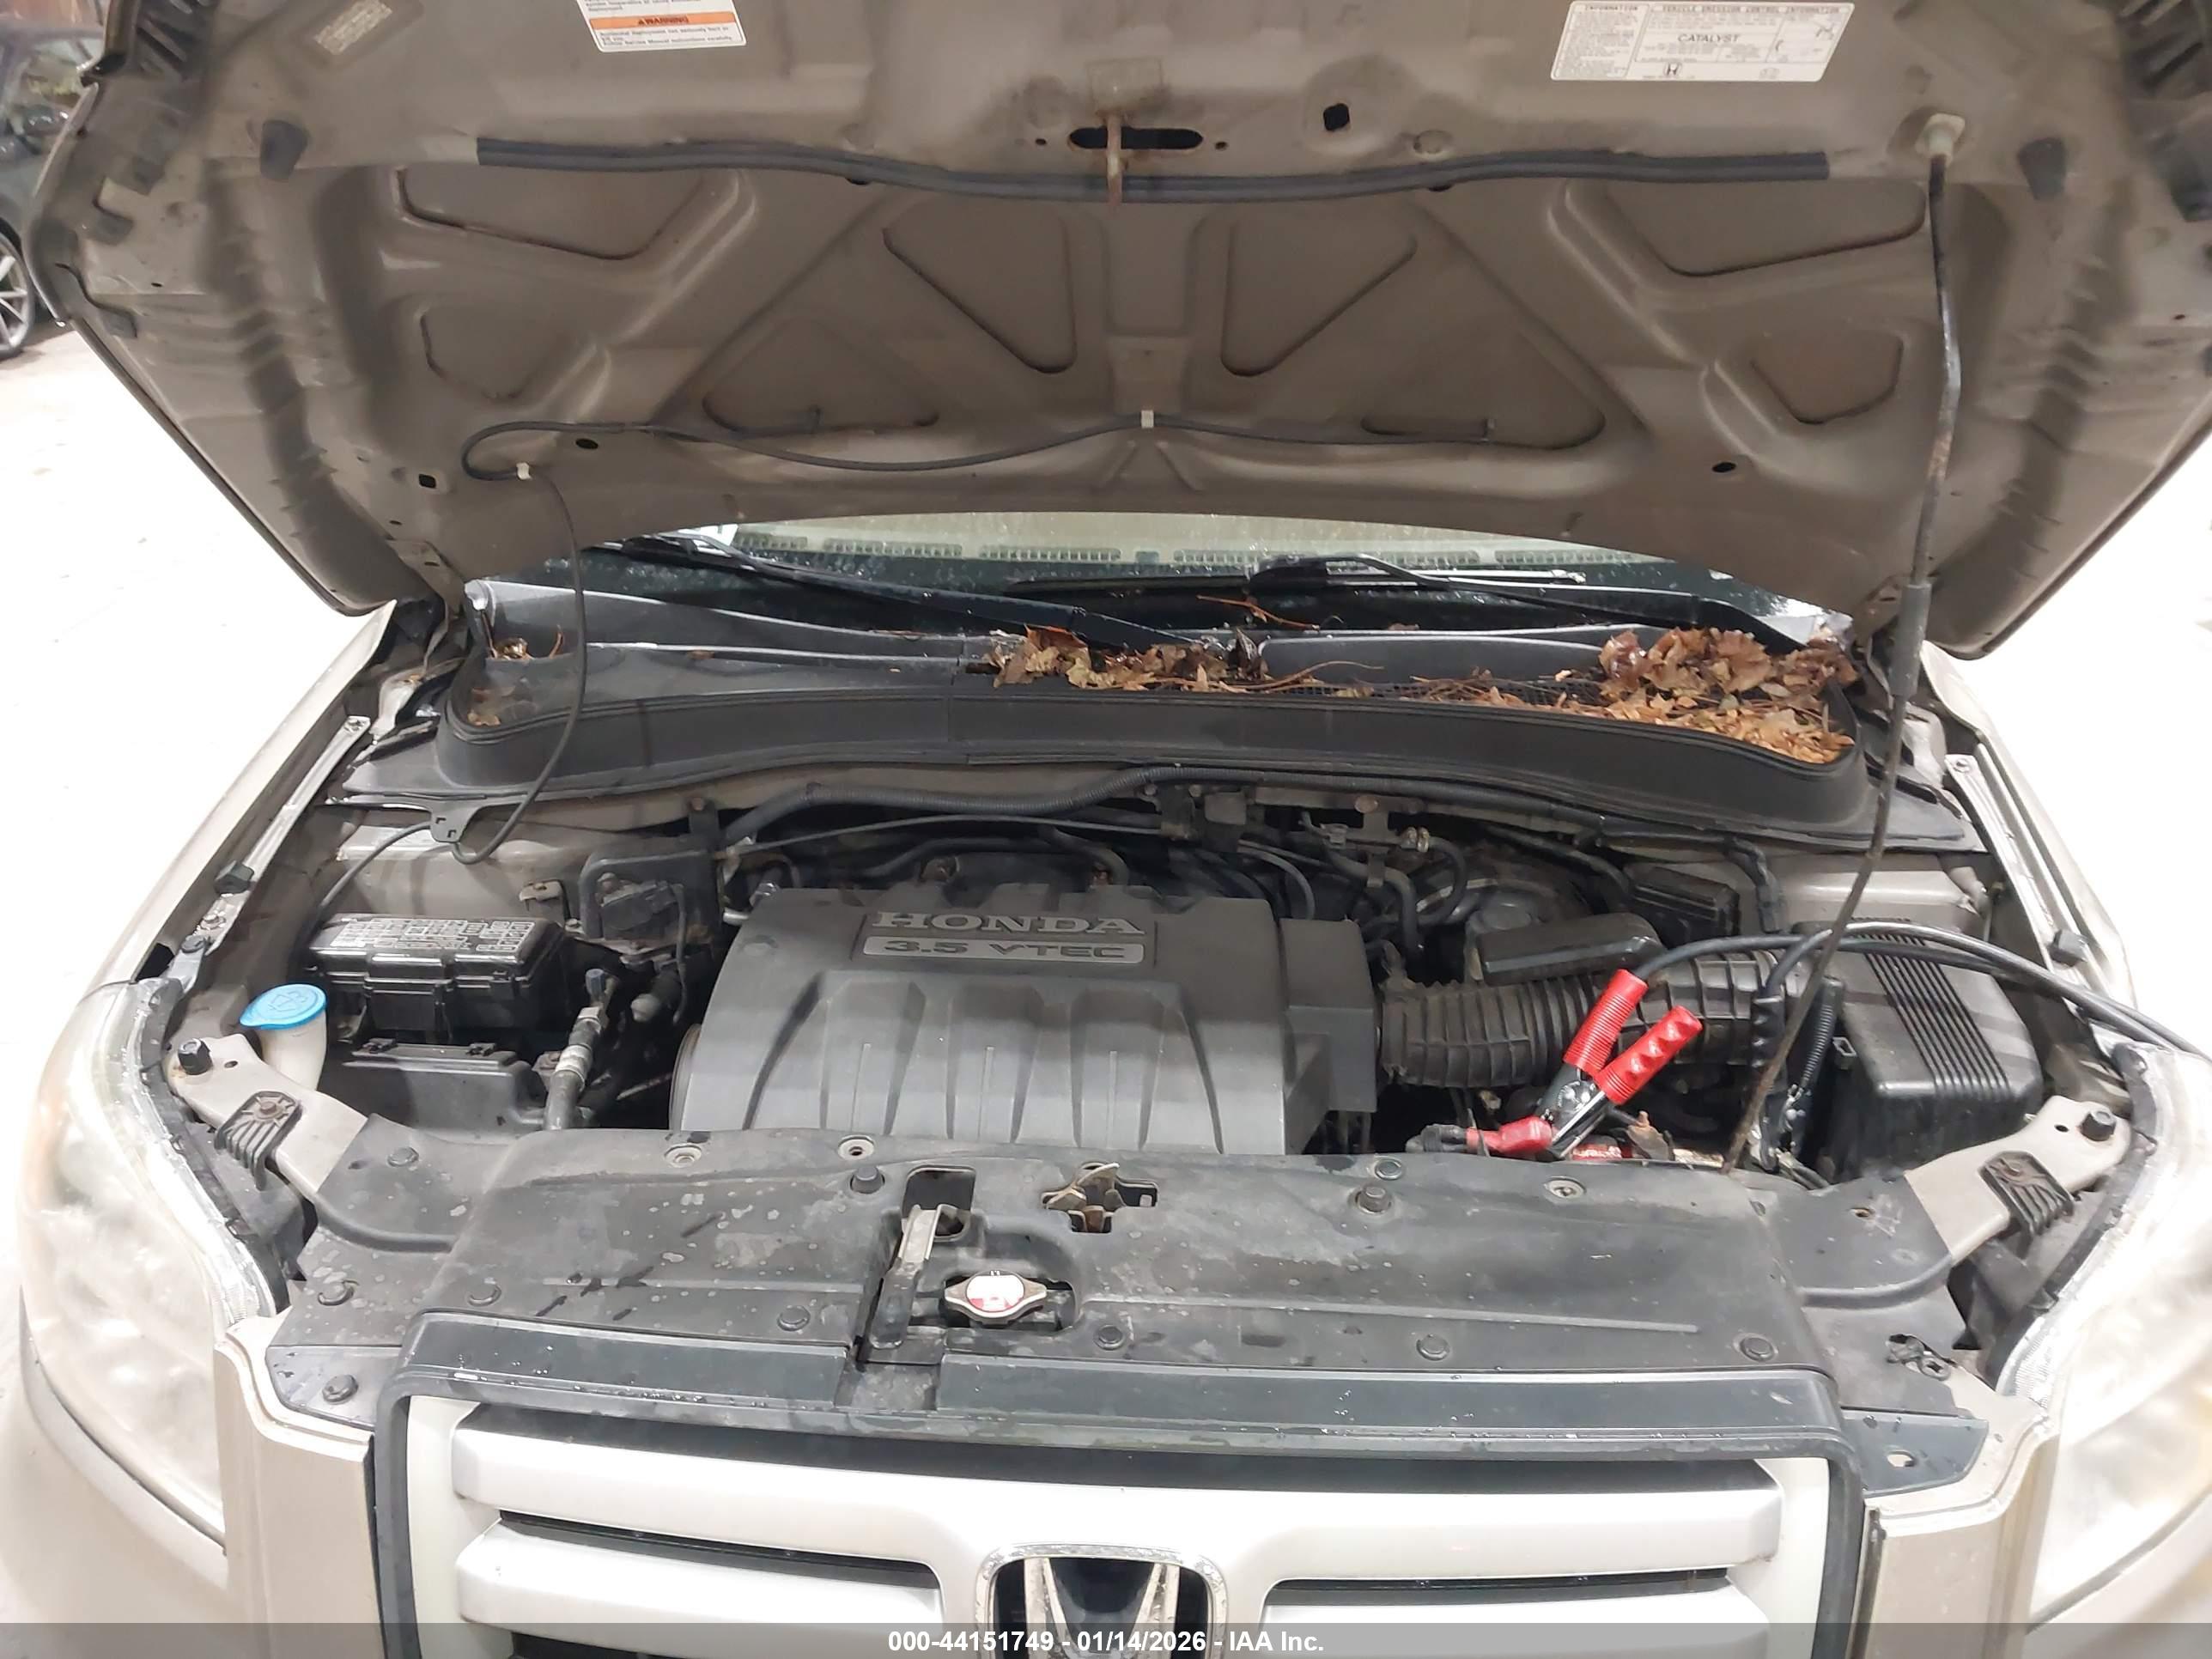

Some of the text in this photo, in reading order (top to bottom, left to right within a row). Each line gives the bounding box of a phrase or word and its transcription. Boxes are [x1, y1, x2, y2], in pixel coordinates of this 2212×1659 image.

[644, 15, 690, 26] WARNING
[1677, 33, 1742, 43] CATALYST
[872, 911, 1146, 935] HONDA
[884, 939, 1126, 958] 3.5 VTEC
